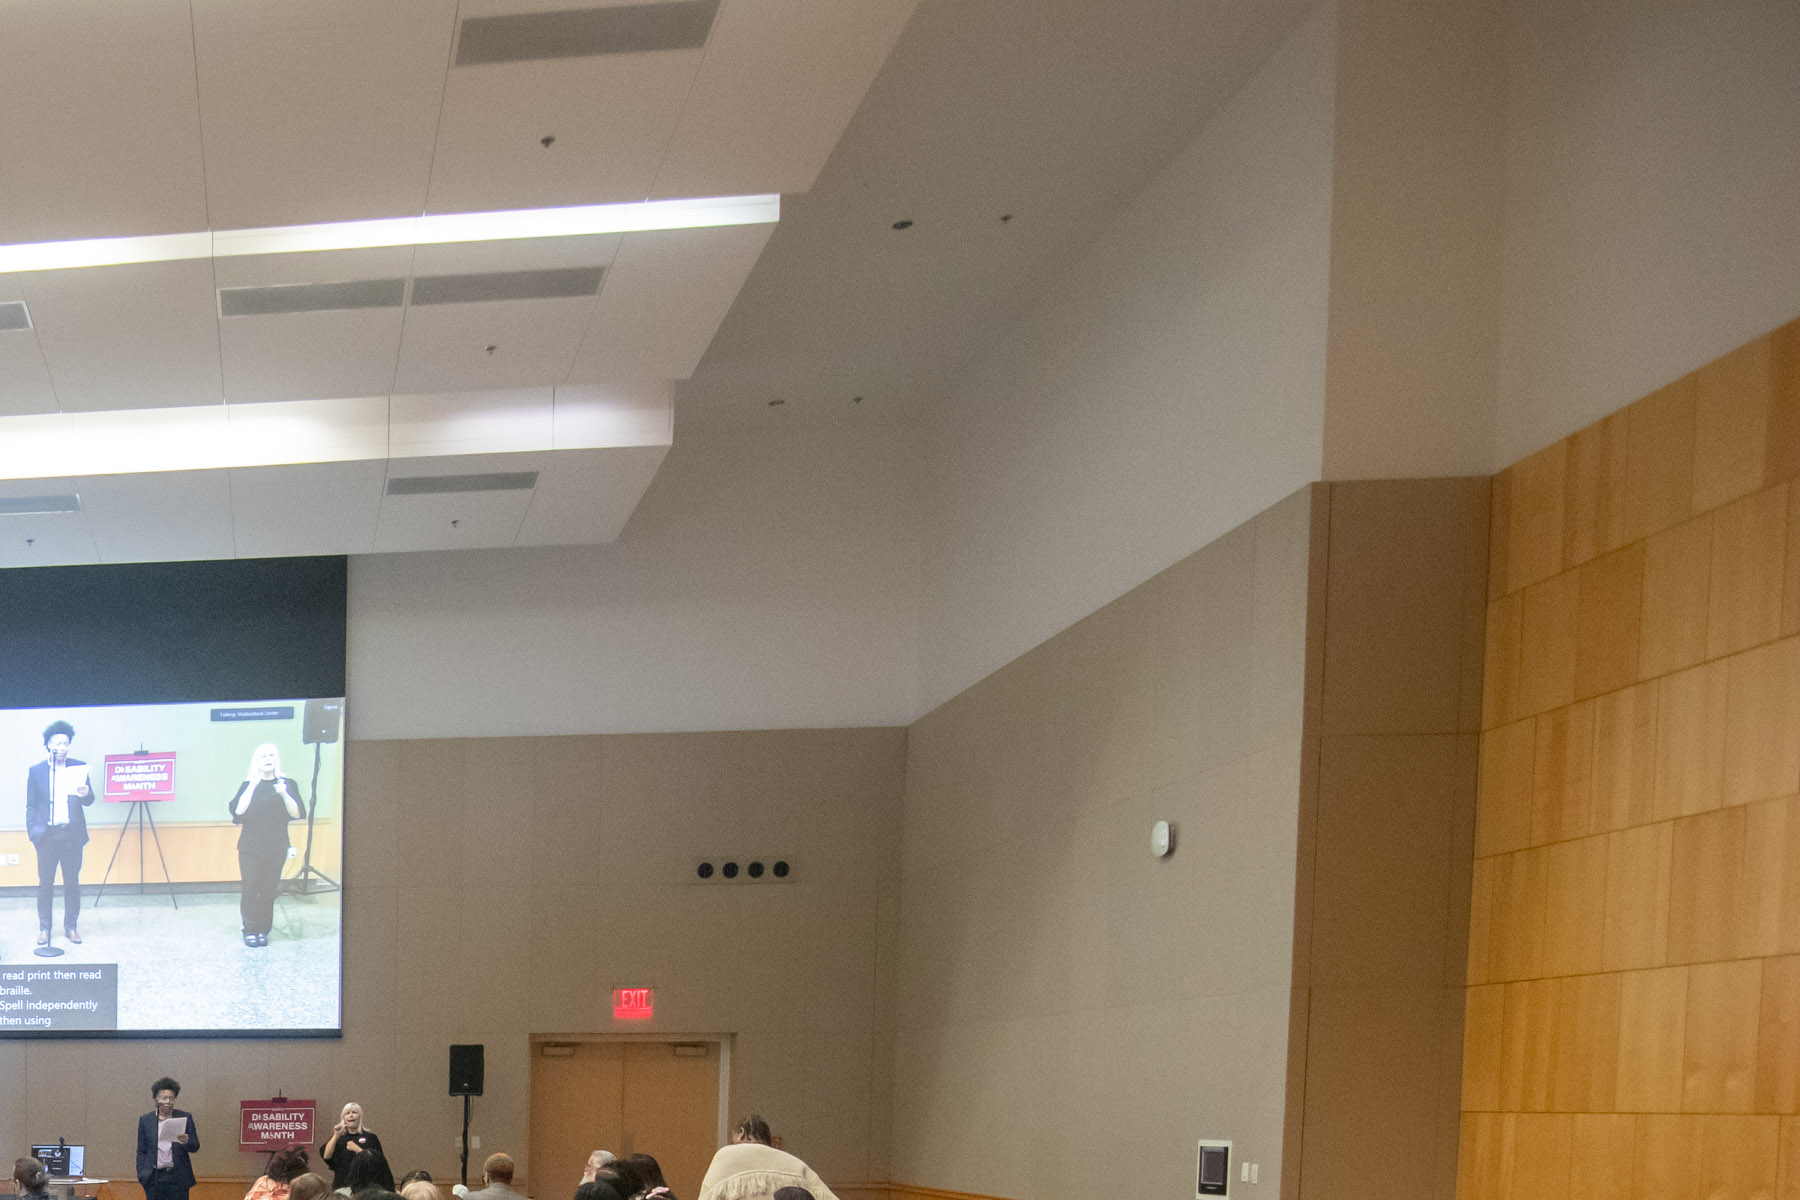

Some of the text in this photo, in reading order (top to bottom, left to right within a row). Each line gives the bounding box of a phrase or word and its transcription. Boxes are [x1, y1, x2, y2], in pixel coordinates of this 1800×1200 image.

[2, 970, 24, 980] read
[27, 970, 51, 982] print
[53, 970, 76, 980] then
[79, 969, 102, 980] read
[0, 985, 32, 996] braille.
[622, 990, 649, 1008] EXIT
[0, 1000, 98, 1012] Spell independently
[0, 1016, 51, 1027] then using
[251, 1112, 305, 1121] DISABILITY
[247, 1122, 308, 1130] AWARENESS
